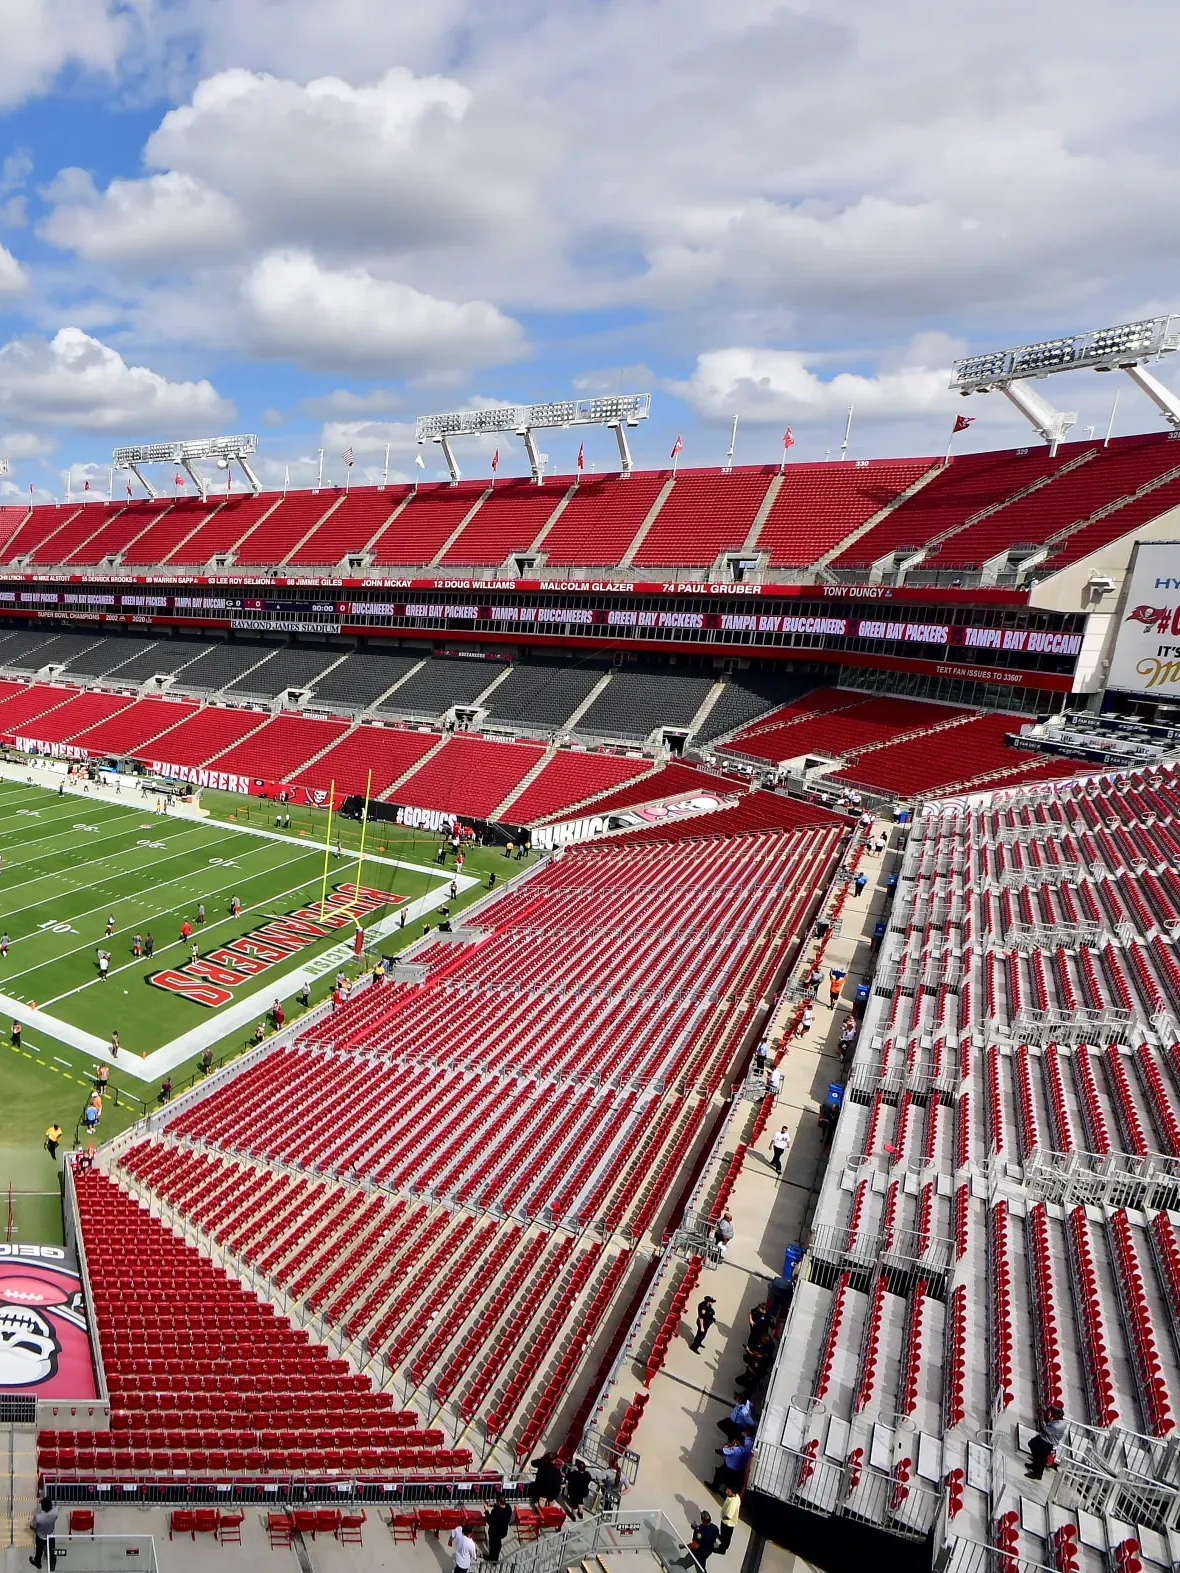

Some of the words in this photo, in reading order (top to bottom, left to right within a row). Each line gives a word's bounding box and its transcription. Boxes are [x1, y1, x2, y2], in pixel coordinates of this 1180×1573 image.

[1016, 448, 1028, 456] 329
[854, 460, 869, 468] 330
[154, 576, 178, 584] WARREN
[384, 580, 412, 588] MCKAY
[434, 580, 442, 588] 12
[444, 580, 470, 588] DOUG
[472, 580, 516, 590] WILLIAMS
[540, 582, 590, 591] MALCOLM
[592, 583, 634, 592] GLAZER
[662, 584, 674, 592] 74
[678, 584, 708, 593] PAUL
[710, 584, 762, 594] GRUBER
[823, 586, 848, 596] TONY
[849, 587, 884, 598] DUNGY
[20, 592, 32, 602] GREEN
[32, 593, 40, 602] BAY
[40, 593, 58, 602] PACKERS
[64, 594, 78, 603] TAMPA
[78, 594, 87, 604] BAY
[87, 594, 114, 604] BUCCANEERS
[122, 596, 136, 605] GREEN
[136, 596, 145, 606] BAY
[146, 596, 166, 606] PACKERS
[174, 598, 192, 608] TAMPA
[192, 598, 202, 608] BAY
[312, 604, 334, 612] 90:00
[231, 620, 272, 630] RAYMOND
[272, 622, 300, 631] JAMES
[302, 624, 340, 634] STADIUM
[352, 602, 394, 616] BUCCANEERS
[406, 604, 428, 616] GREEN
[428, 606, 444, 618] BAY
[444, 606, 478, 619] PACKERS
[491, 607, 518, 620] TAMPA
[520, 608, 536, 622] BAY
[538, 608, 593, 624] BUCCANEERS
[608, 611, 638, 625] GREEN
[638, 612, 658, 626] BAY
[658, 613, 704, 628] PACKERS
[720, 615, 756, 630] TAMPA
[758, 616, 782, 632] BAY
[782, 617, 846, 635] BUCCANEERS
[858, 620, 886, 638] GREEN
[886, 622, 906, 640] BAY
[904, 624, 948, 644] PACKERS
[964, 628, 1002, 648] TAMPA
[1002, 630, 1028, 650] BAY
[936, 666, 952, 674] TEXT
[952, 667, 966, 676] FAN
[966, 669, 992, 679] ISSUES
[993, 672, 1002, 680] TO
[1003, 673, 1022, 682] 33607
[16, 736, 88, 758] BUCCANEERS
[152, 761, 250, 794] BUCCANEERS
[396, 806, 458, 832] #GOBUCS
[36, 919, 73, 934] 10
[148, 882, 411, 1008] BUCCANEERS
